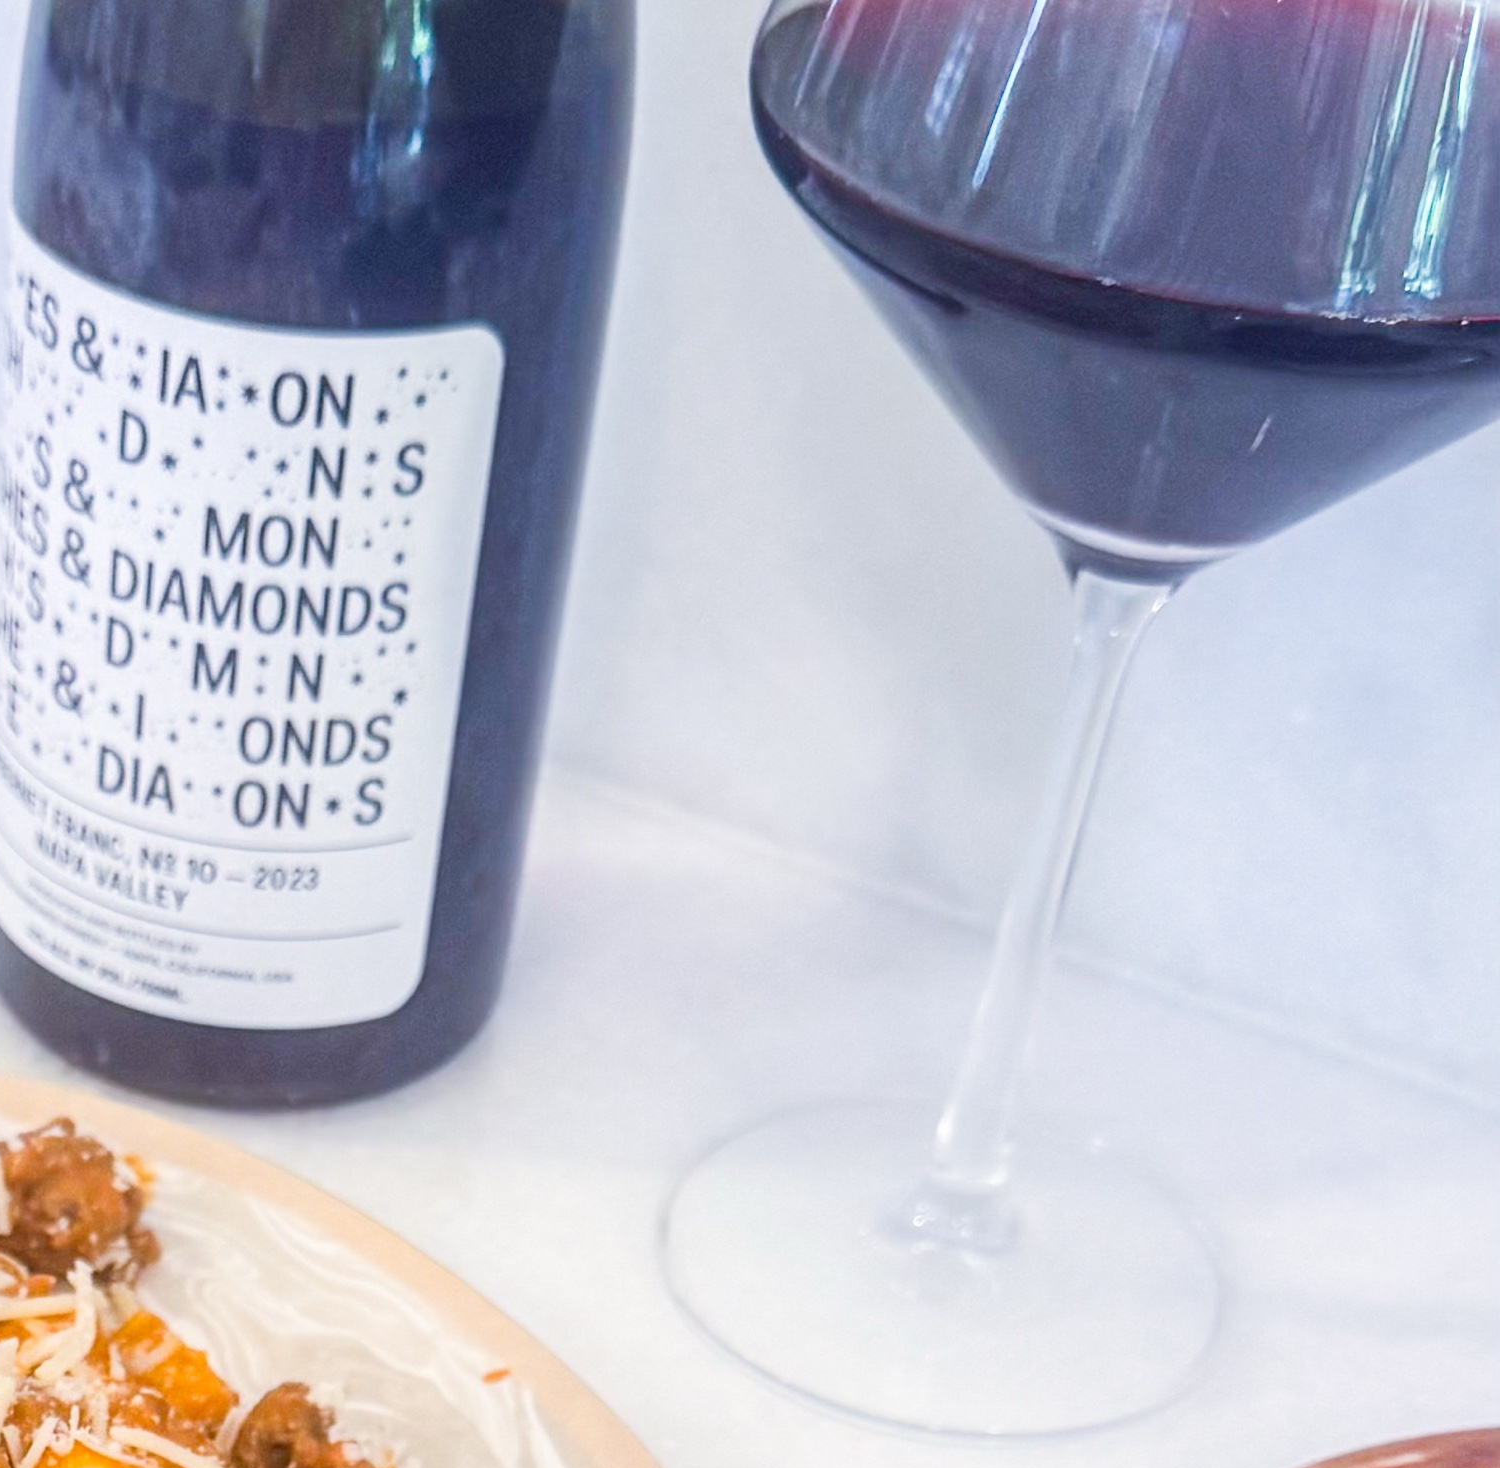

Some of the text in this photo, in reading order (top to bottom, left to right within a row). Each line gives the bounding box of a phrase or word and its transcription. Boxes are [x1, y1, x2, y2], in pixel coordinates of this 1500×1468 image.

[72, 316, 103, 380] &
[159, 350, 207, 413] IA
[270, 372, 354, 429] ON
[119, 409, 147, 464] D
[308, 446, 346, 500] N
[393, 443, 426, 496] S
[64, 459, 95, 521] &
[203, 506, 339, 568] MON
[60, 528, 90, 588] &
[111, 549, 410, 636] DIAMONDS
[107, 617, 133, 667] D
[193, 642, 237, 697] M
[288, 654, 324, 702] N
[54, 659, 82, 718] &
[239, 714, 392, 767] ONDS
[98, 745, 175, 814] DIA
[233, 780, 311, 829] ON
[353, 777, 386, 826] S
[95, 862, 190, 913] VALLEY
[188, 858, 218, 885] 10
[254, 866, 320, 892] 2023
